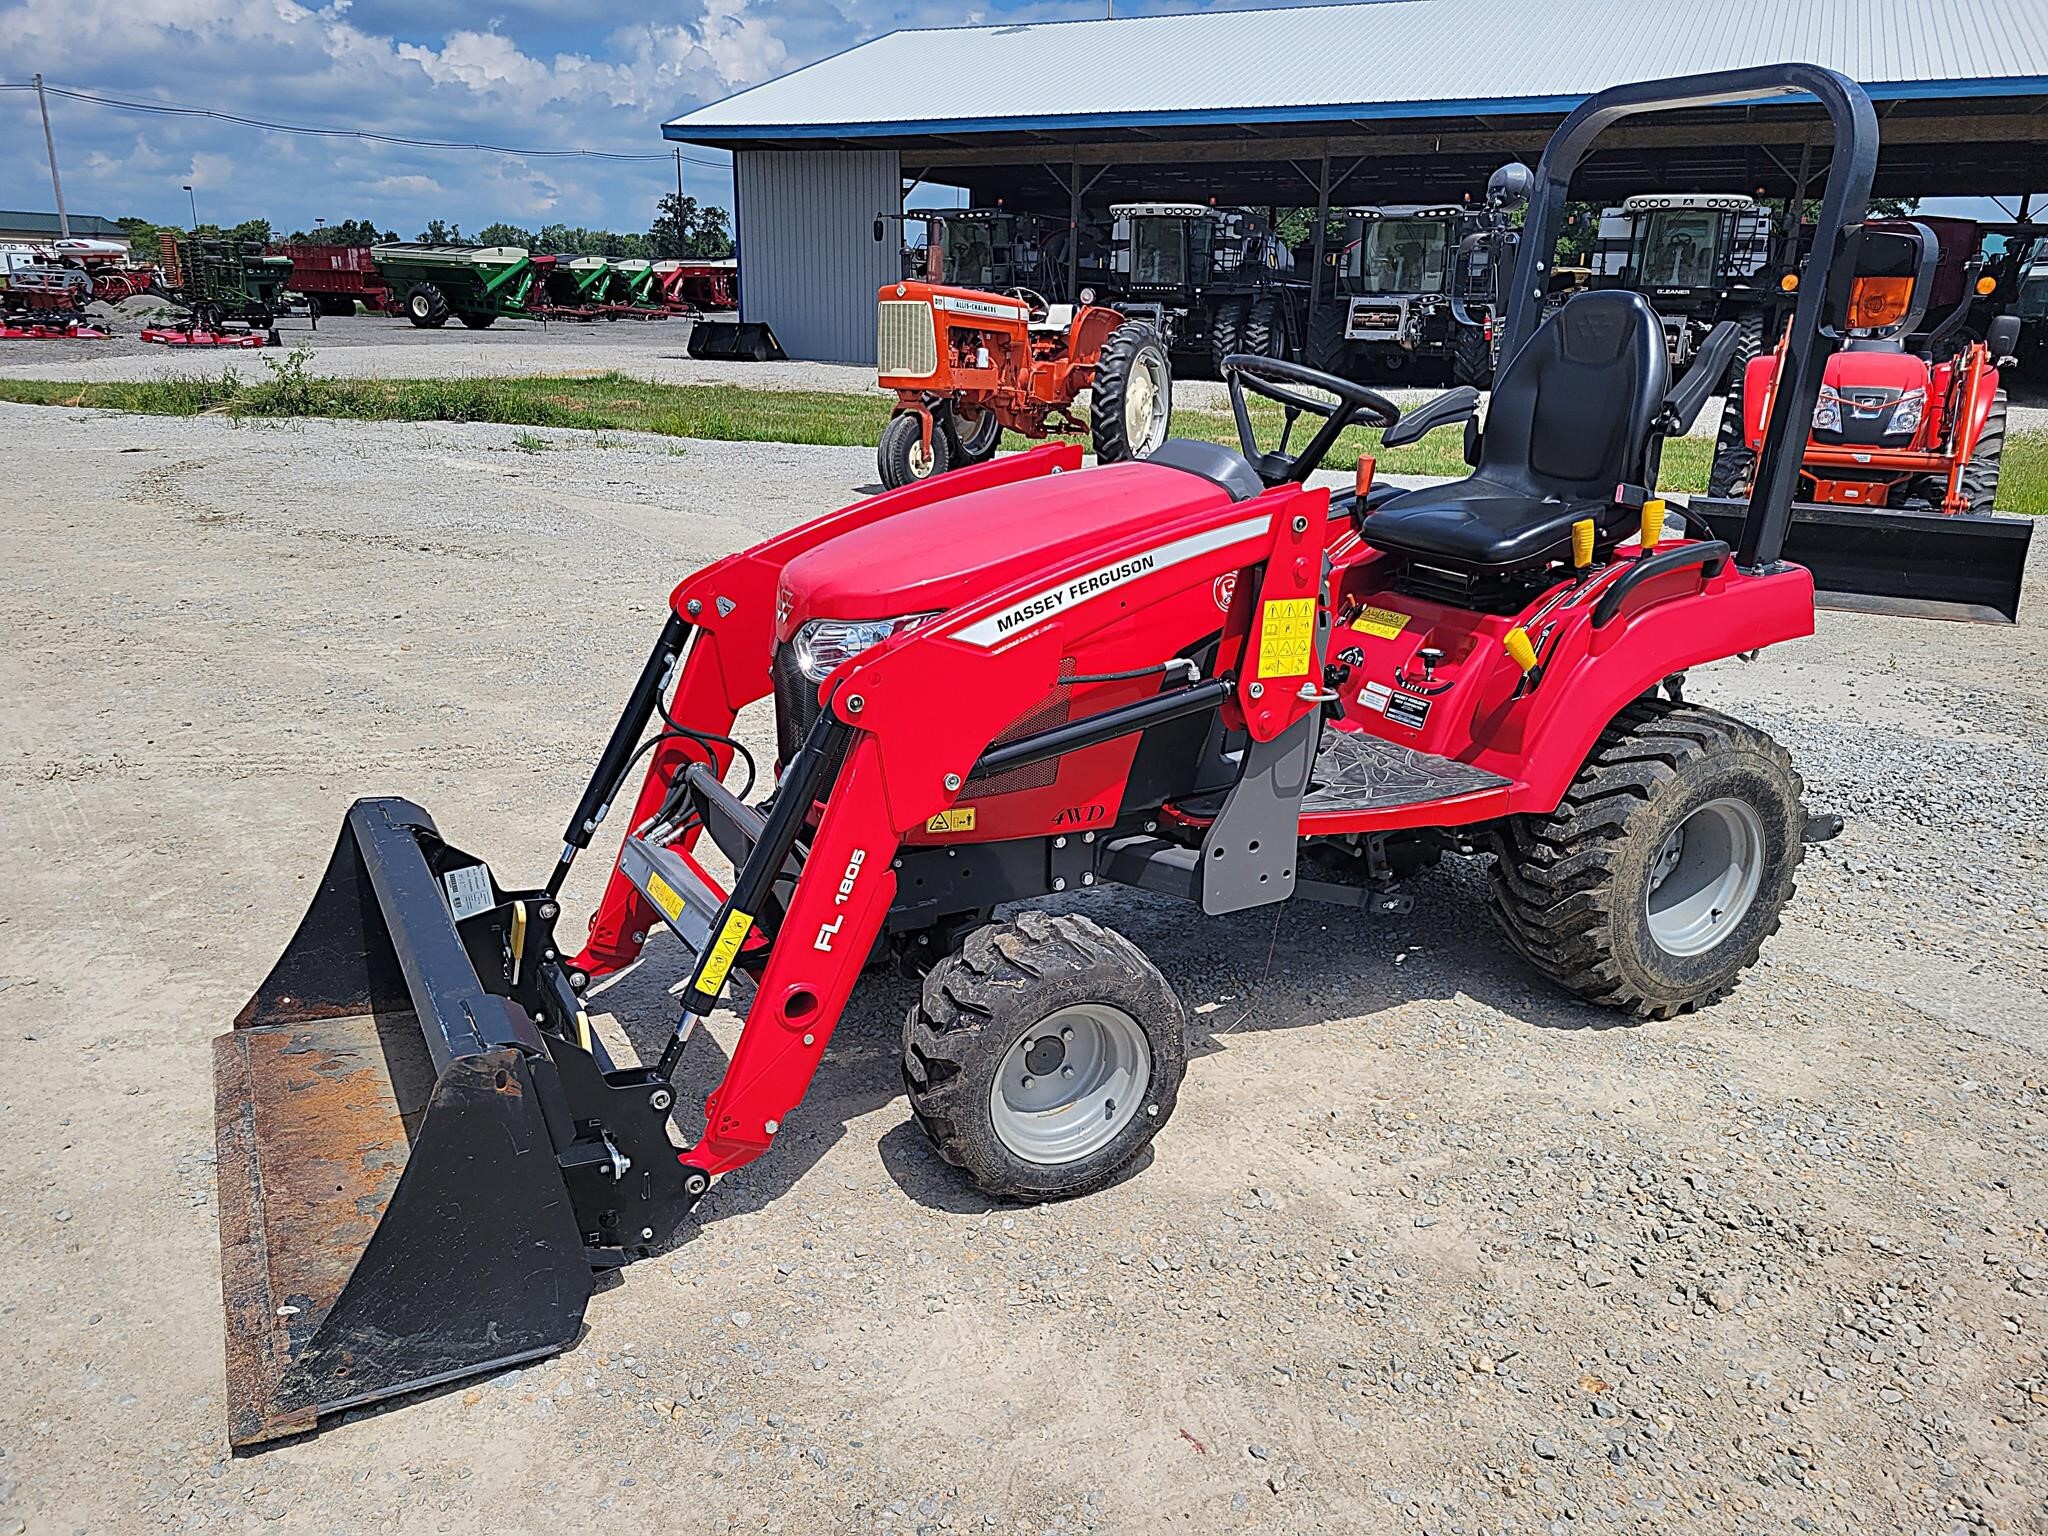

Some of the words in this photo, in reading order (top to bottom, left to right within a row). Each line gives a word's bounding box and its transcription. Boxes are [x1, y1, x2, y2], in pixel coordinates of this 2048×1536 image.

[956, 301, 997, 314] ALLIS-CHALMERS
[996, 590, 1064, 632] MASSEY
[1068, 554, 1155, 600] FERGUSON
[1049, 804, 1106, 826] 4WD
[813, 914, 844, 952] FL
[834, 848, 866, 906] 1805
